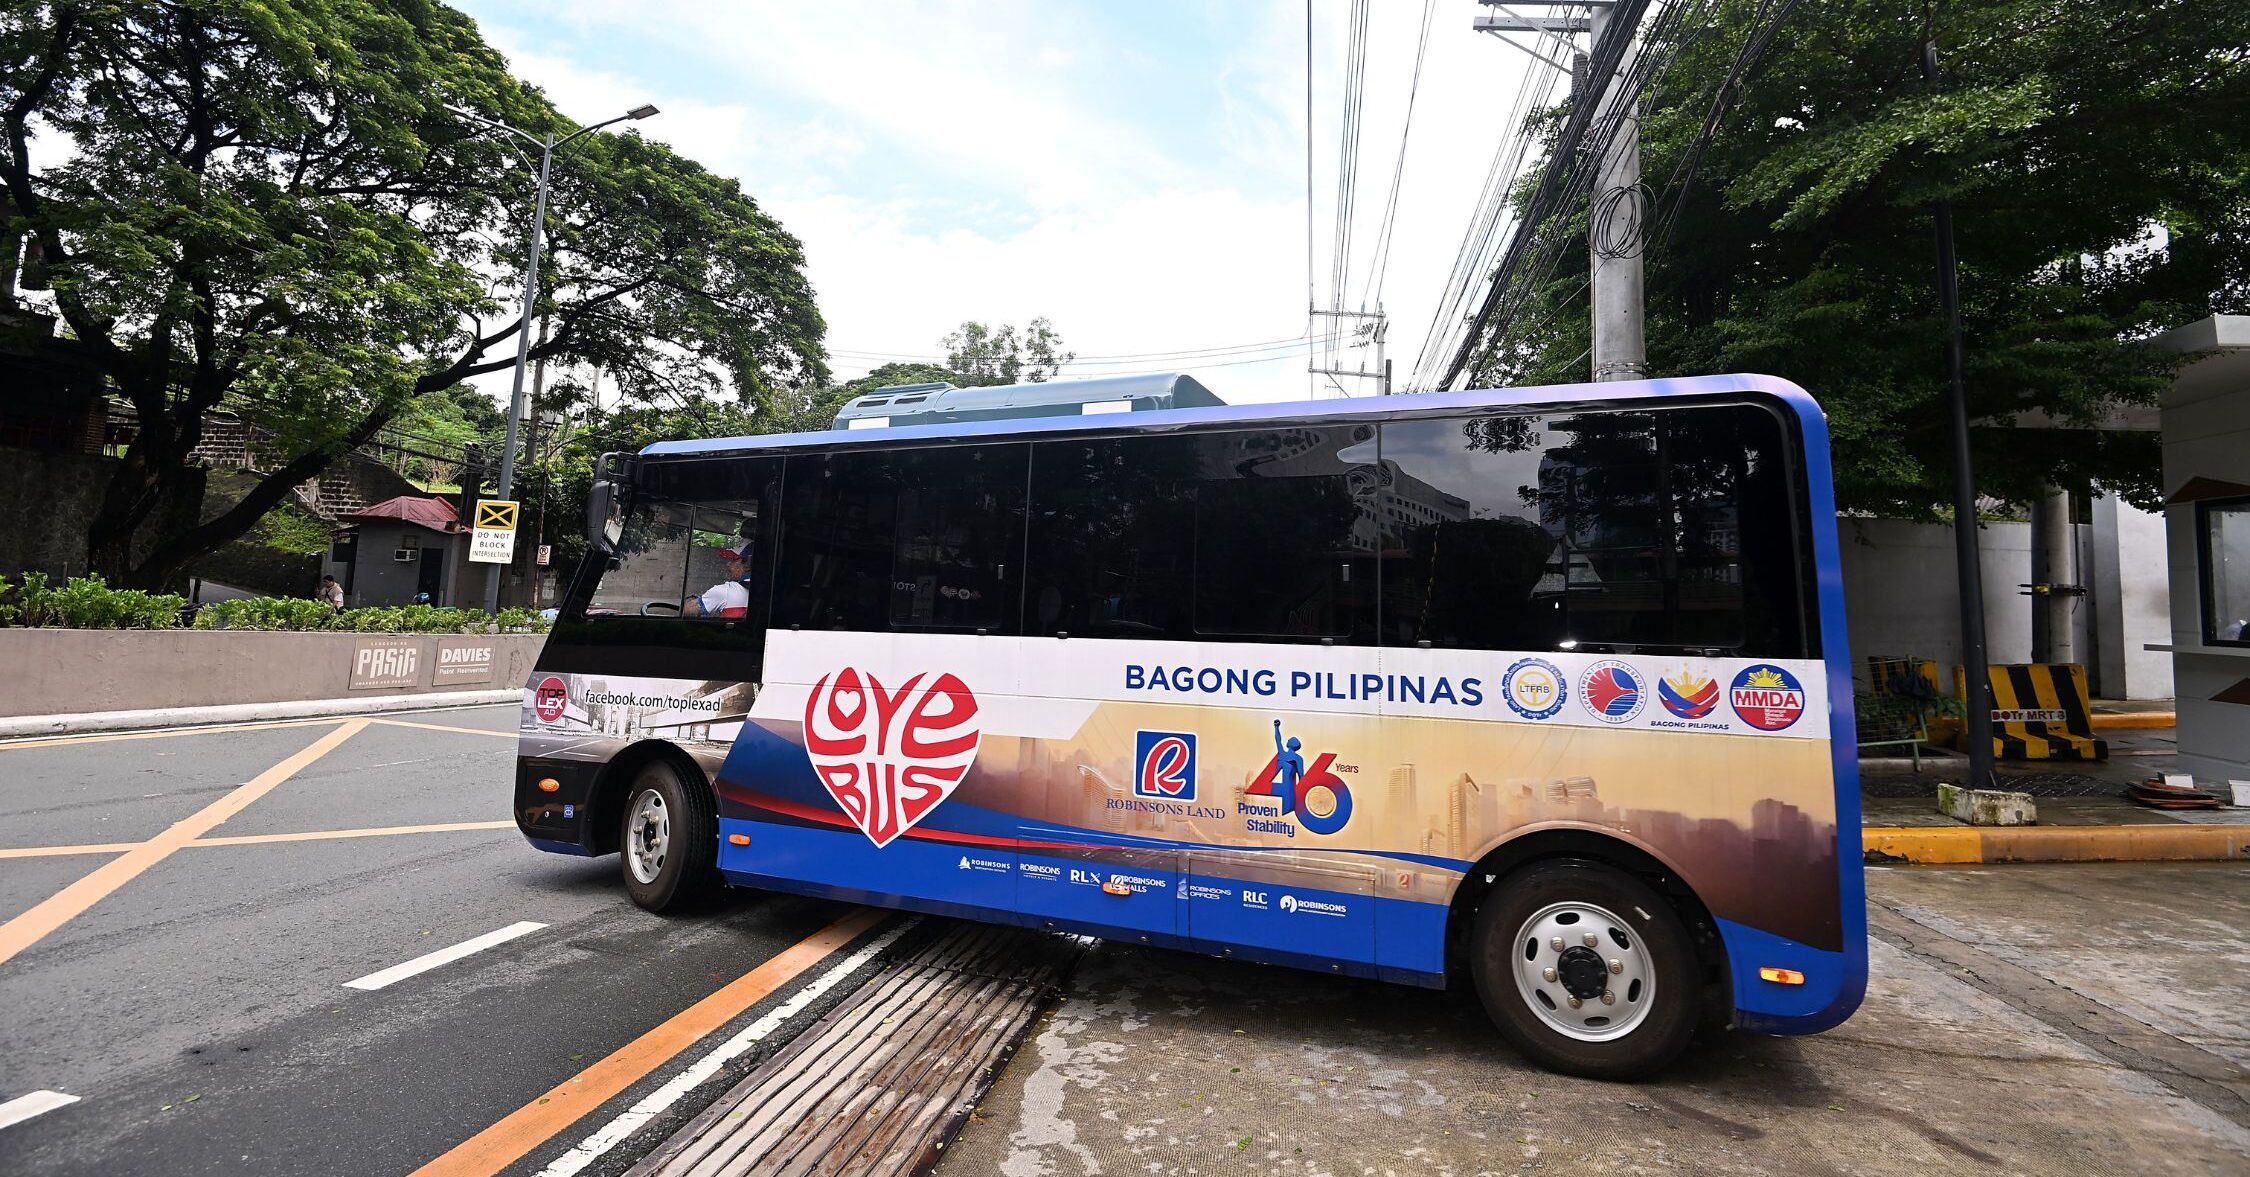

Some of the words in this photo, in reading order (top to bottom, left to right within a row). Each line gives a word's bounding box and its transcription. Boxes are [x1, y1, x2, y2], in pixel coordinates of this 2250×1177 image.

[480, 541, 506, 549] BLOCK
[472, 550, 510, 558] INTERSECTION
[440, 647, 491, 663] DAVIES
[1126, 665, 1277, 696] BAGONG
[1291, 672, 1484, 706] PILIPINAS
[1520, 685, 1550, 694] LTFRB
[539, 687, 566, 698] TOP
[1734, 690, 1800, 708] MMDA
[537, 696, 564, 710] LEX
[585, 689, 721, 712] facebook.com/toplexad
[2027, 711, 2057, 720] MRT
[1650, 720, 1686, 728] BAGONG
[1688, 722, 1730, 730] PILIPINAS
[1335, 763, 1359, 773] Years
[1244, 752, 1353, 835] 46
[816, 762, 968, 845] BUS
[1106, 799, 1184, 815] ROBINSONS
[1187, 806, 1226, 819] LAND
[1238, 802, 1278, 817] Proven
[1247, 819, 1295, 838] Stability
[971, 859, 1011, 870] ROBINSONS
[1020, 863, 1061, 875] ROBINSONS
[1124, 875, 1166, 888] ROBINSONS
[1189, 885, 1232, 896] ROBINSONS
[1243, 890, 1268, 905] RLC
[1298, 900, 1347, 913] ROBINSONS
